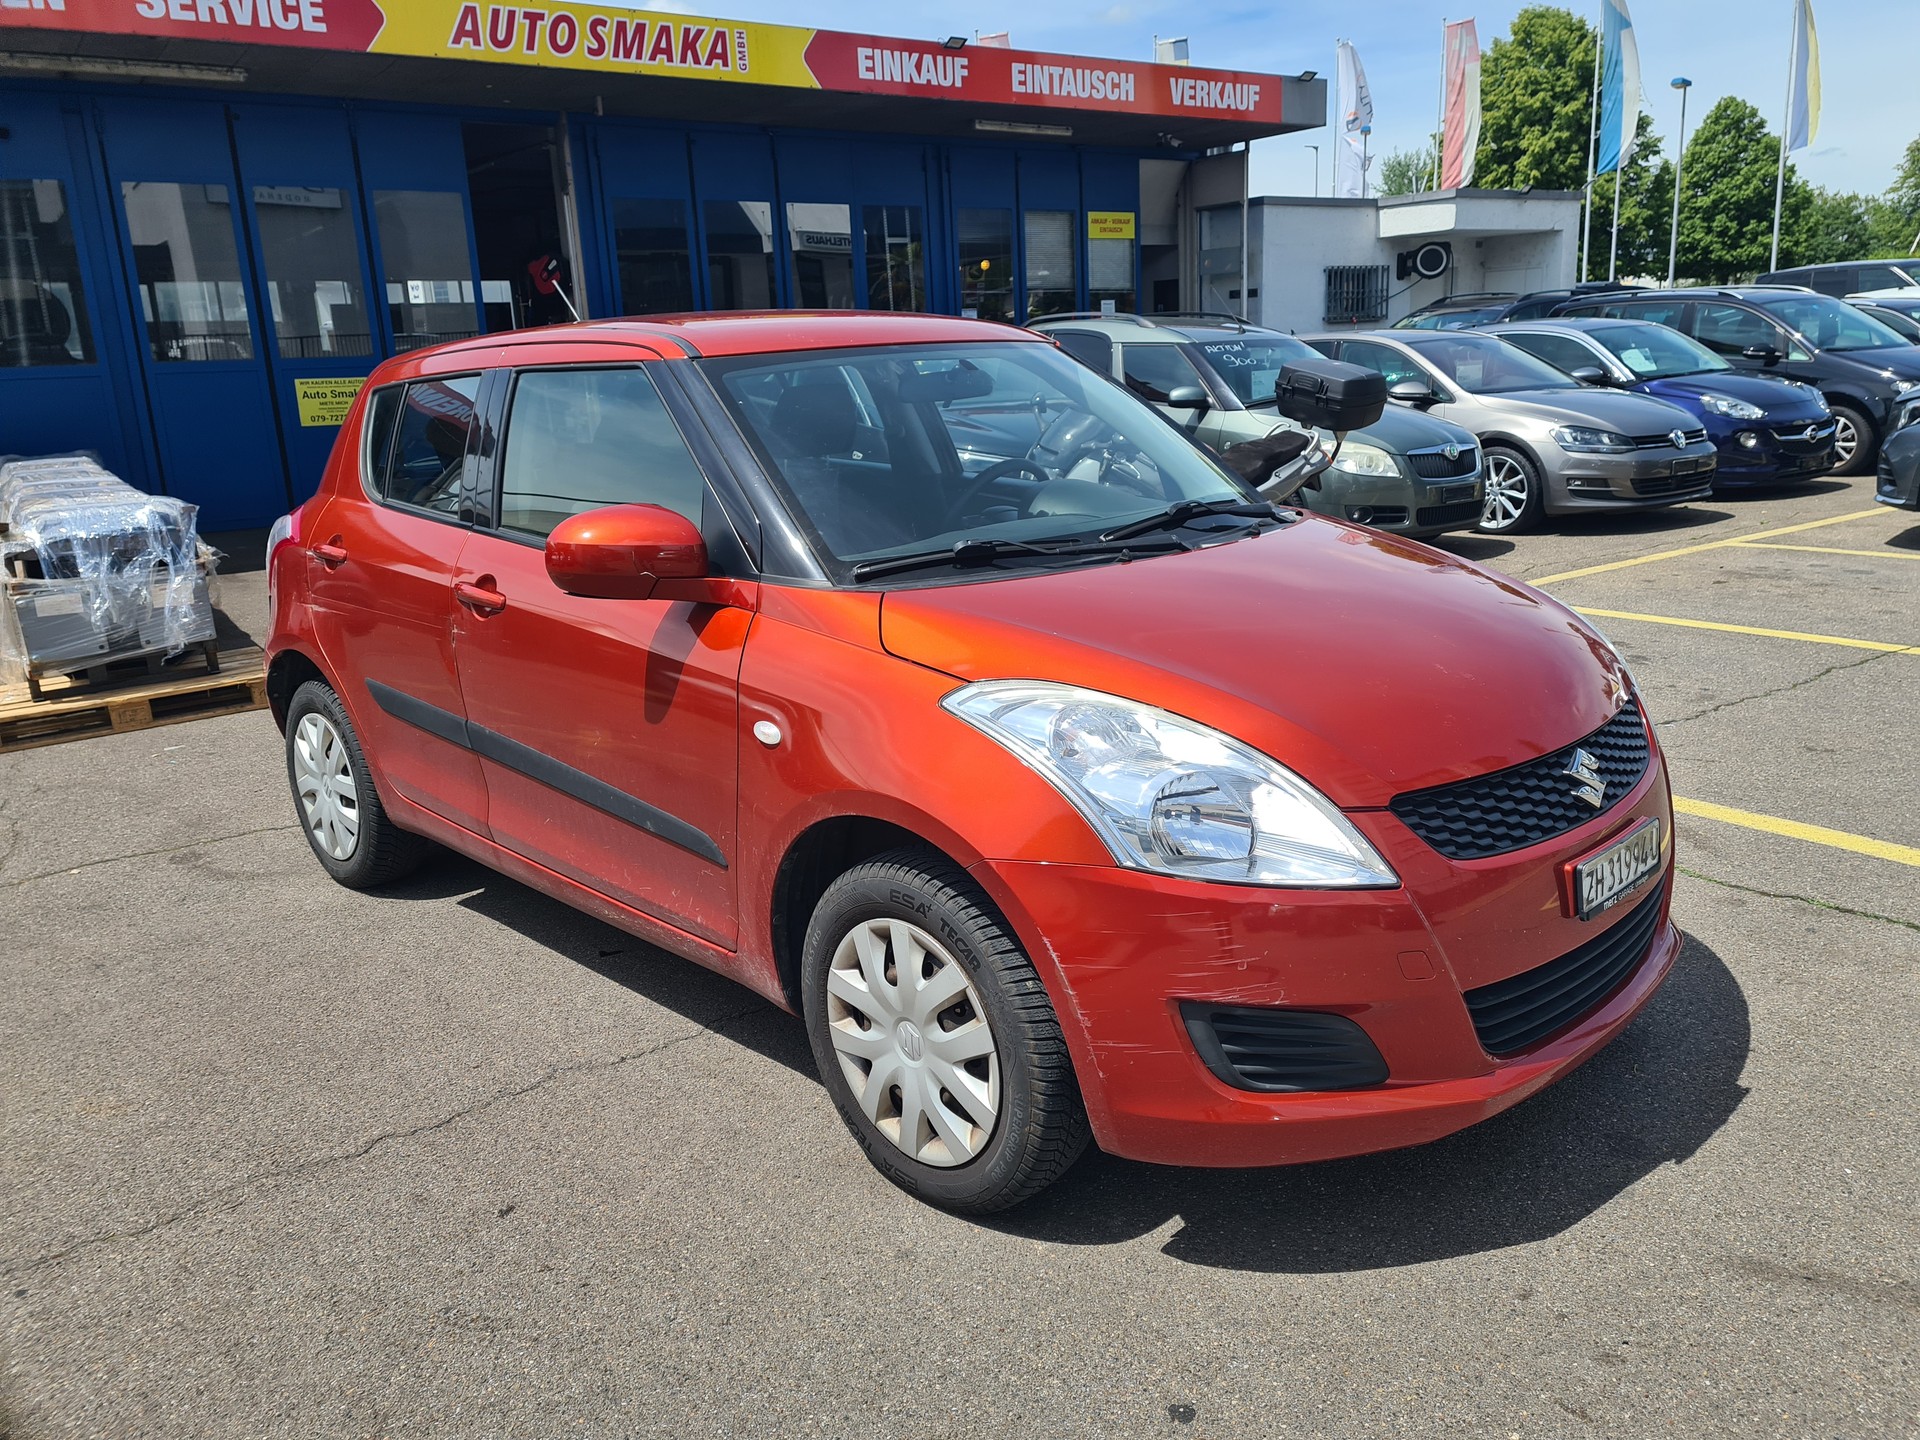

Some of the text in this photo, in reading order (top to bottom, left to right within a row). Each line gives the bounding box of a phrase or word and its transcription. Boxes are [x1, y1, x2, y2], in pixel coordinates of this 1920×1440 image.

[135, 0, 327, 33] SERVICE
[447, 1, 732, 73] AUTO SMAKA
[735, 28, 749, 73] GMBH
[857, 46, 1261, 112] EINKAUF EINTAUSCH VERKAUF
[302, 390, 328, 400] Auto
[1586, 863, 1605, 906] ZH
[939, 917, 981, 973] TECAR
